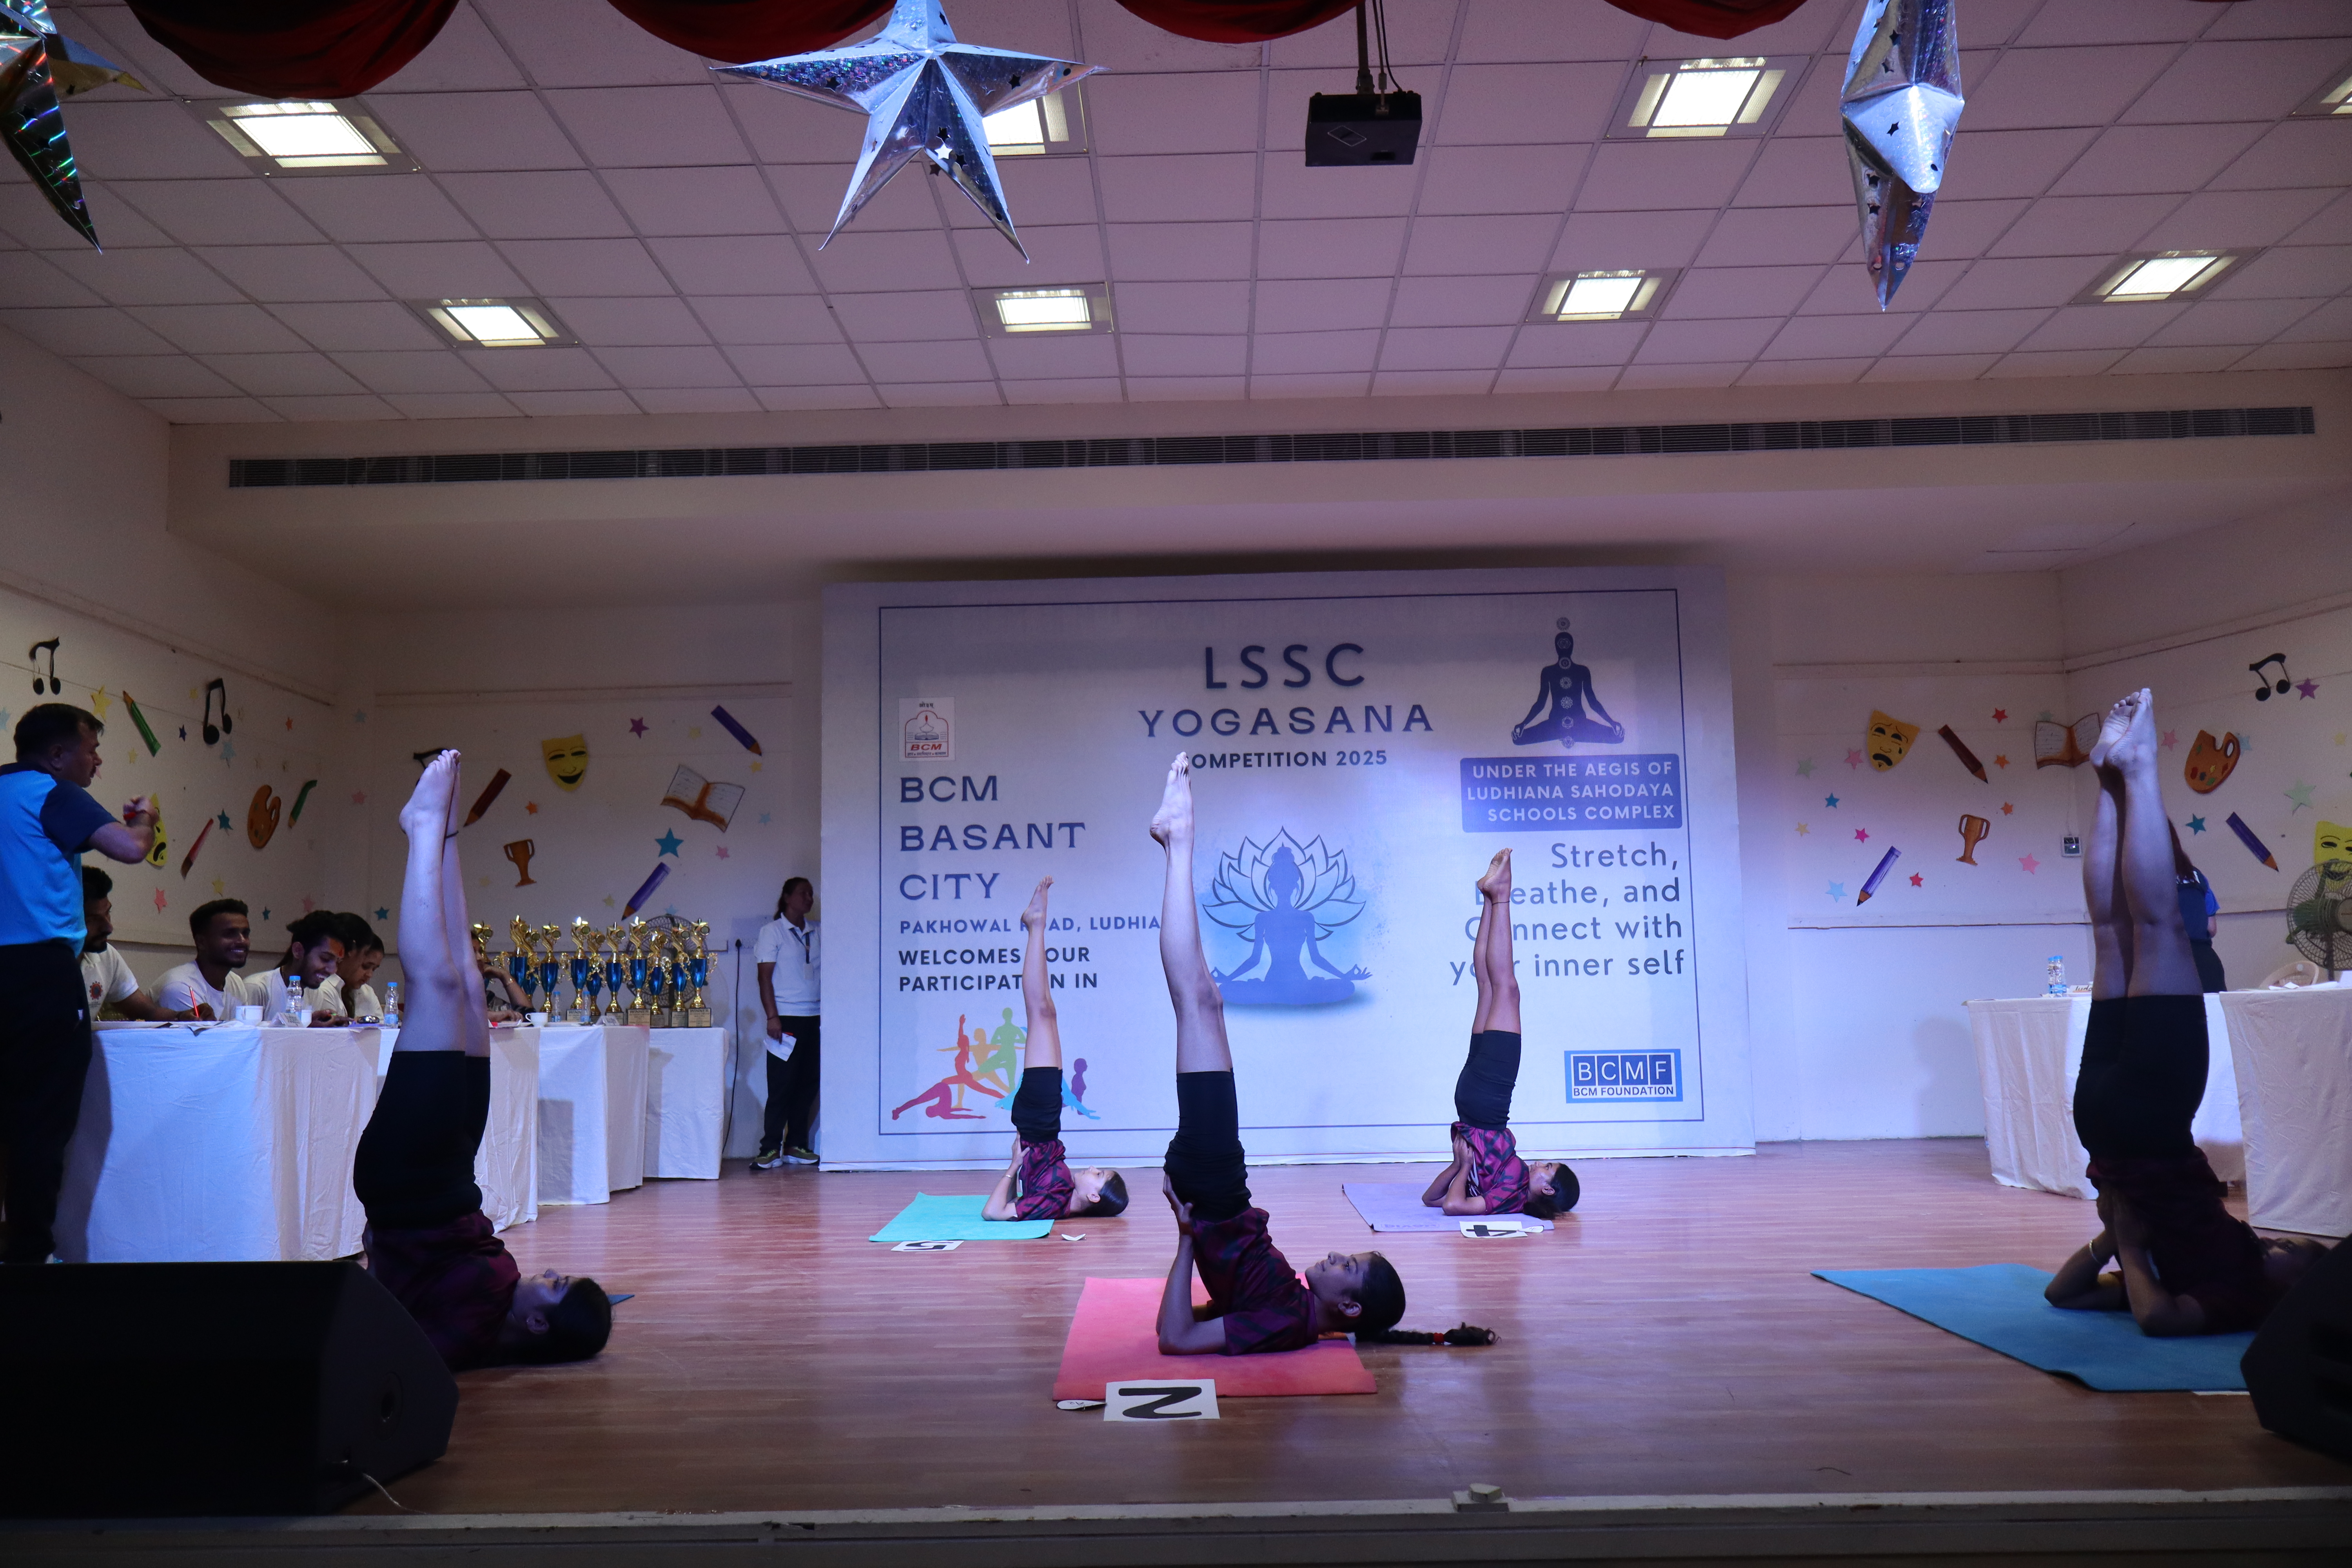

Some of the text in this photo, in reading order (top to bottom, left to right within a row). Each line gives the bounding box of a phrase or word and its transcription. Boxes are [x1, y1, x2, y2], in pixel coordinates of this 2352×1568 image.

[1205, 643, 1365, 689] LSSC
[1138, 704, 1434, 737] YOGASANA
[1192, 750, 1387, 769] OMPETITION 2025
[1473, 762, 1671, 778] UNDER THE AEGIS OF
[900, 775, 998, 802] BCM
[1468, 783, 1673, 800] LUDHIANA SAHODAYA
[1488, 805, 1674, 821] SCHOOLS COMPLEX
[900, 822, 1085, 851] BASANT
[1552, 842, 1677, 870] Stretch,
[900, 873, 1000, 900] CITY
[1624, 877, 1680, 902] and
[900, 916, 1160, 934] PAKHOWAL RAD, LUDHIA
[1465, 913, 1682, 941] Cnnect with
[898, 947, 1090, 965] WELCOMES OUR
[1450, 949, 1684, 986] yr inner self
[900, 973, 1097, 992] PARTICIPATN IN
[1579, 1061, 1666, 1081] BCMF
[1573, 1086, 1673, 1096] BCM FOUNDATION
[1466, 1225, 1517, 1237] 4
[903, 1241, 954, 1250] 5
